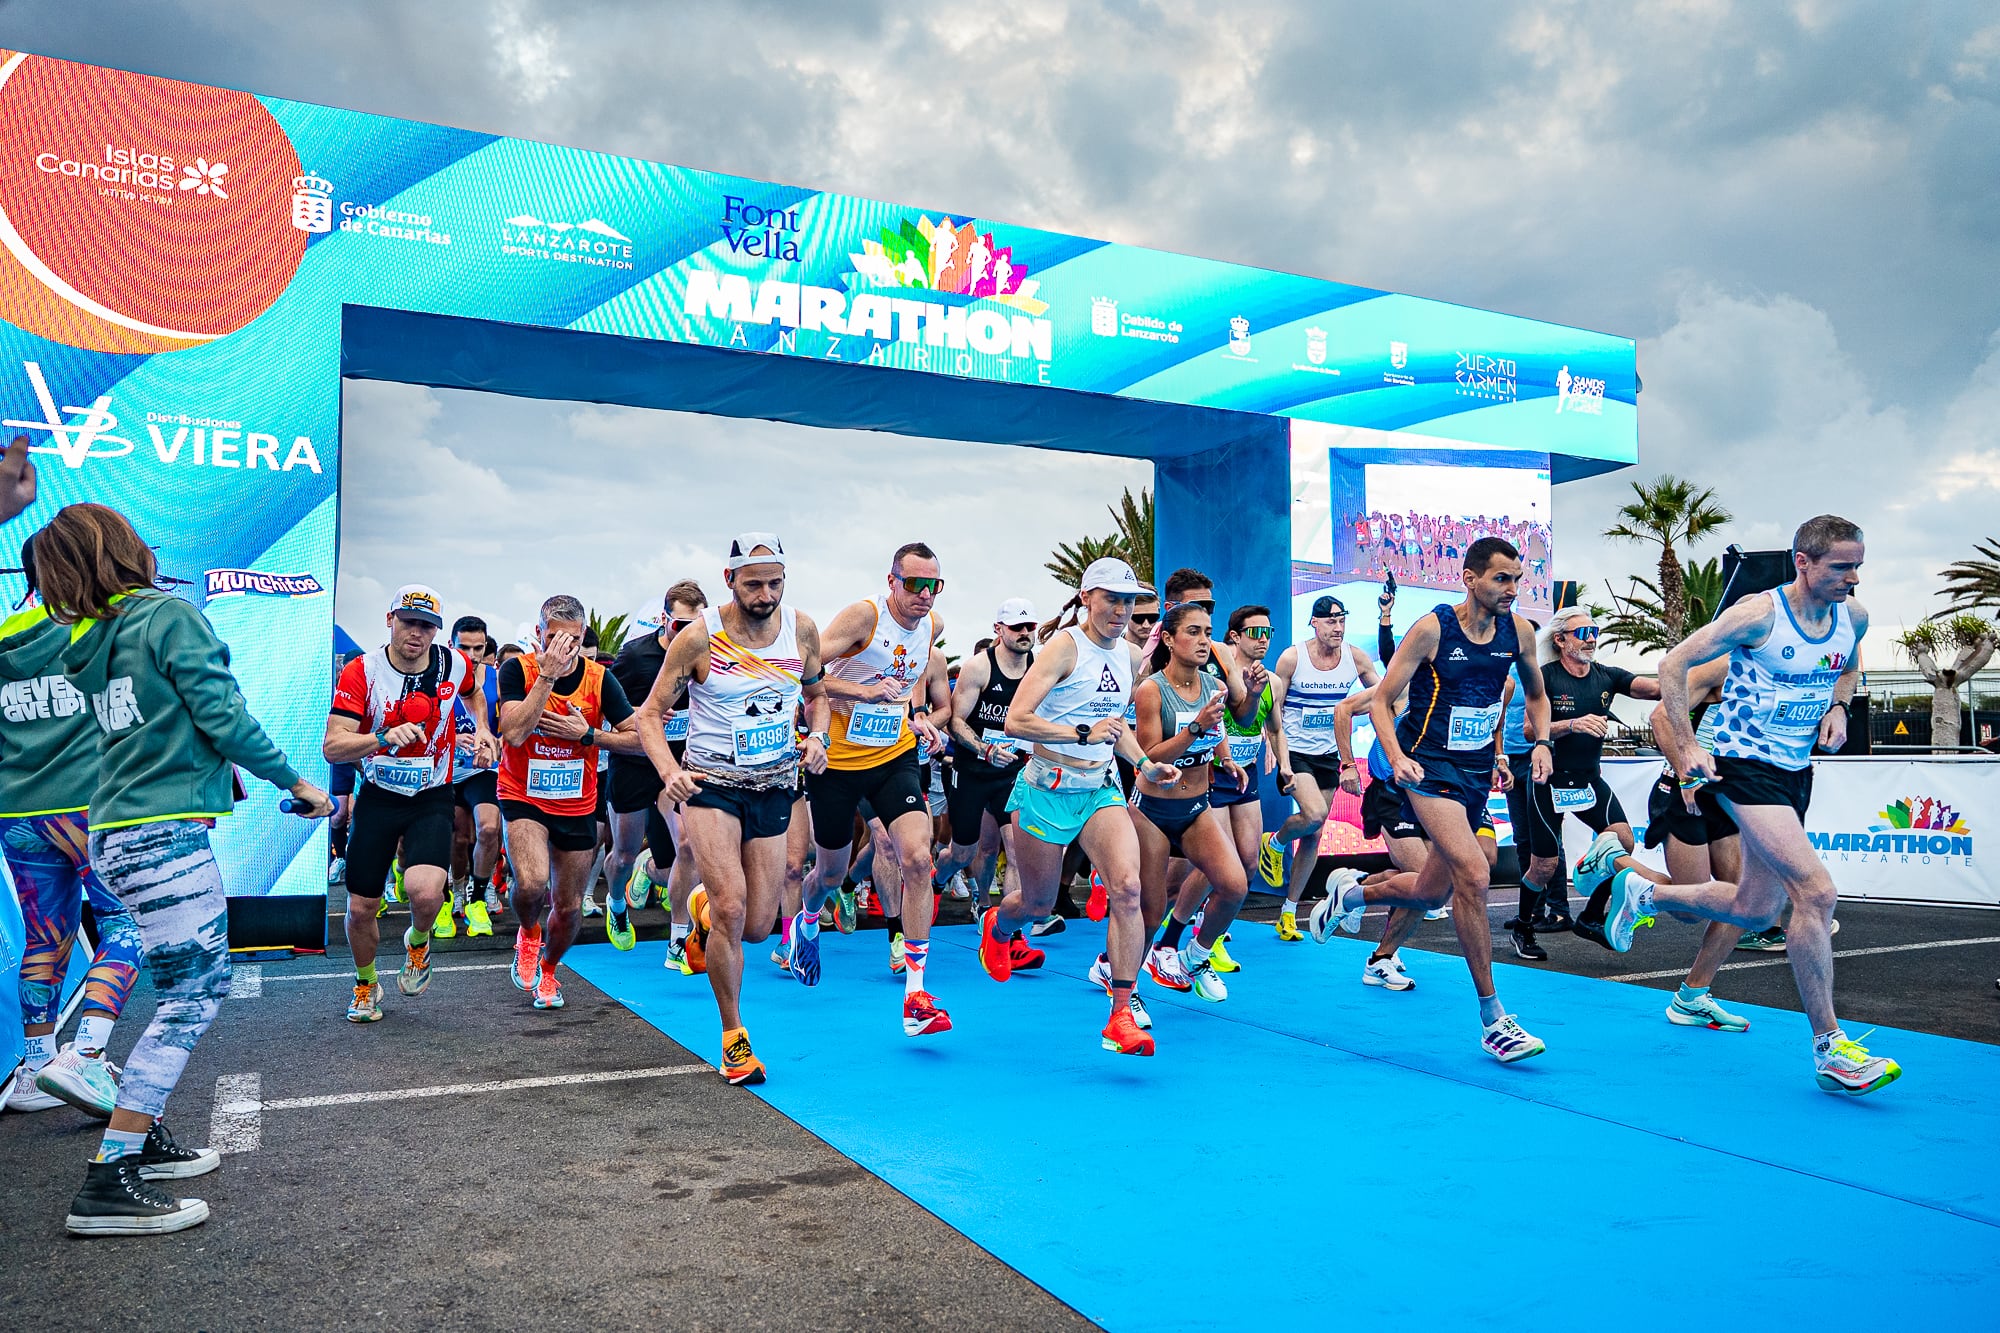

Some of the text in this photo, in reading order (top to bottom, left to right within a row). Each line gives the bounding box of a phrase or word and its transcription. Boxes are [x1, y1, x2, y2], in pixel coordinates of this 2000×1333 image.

[106, 144, 175, 172] Islas
[36, 152, 174, 190] Canarias
[339, 201, 433, 226] Gobierno
[722, 195, 800, 232] Font
[339, 217, 452, 246] de Canarias
[503, 228, 634, 259] LANZAROTE
[720, 224, 801, 263] Vella
[502, 244, 634, 271] SPORTS DESTINATION
[684, 269, 1052, 361] MARATHON
[1121, 312, 1183, 333] Cabildo de
[1121, 325, 1180, 344] Lanzarote
[685, 321, 1052, 384] LANZAROTE
[1571, 386, 1604, 399] BEACH
[1573, 375, 1606, 391] SANDS
[146, 411, 242, 430] Distribuciones
[146, 424, 323, 474] VIERA
[208, 570, 320, 594] Munchitos
[1301, 681, 1336, 689] Lochaber.
[3, 696, 87, 723] GIVE UP!
[1311, 716, 1332, 725] 4515
[1787, 704, 1821, 721] 4922
[865, 717, 891, 733] 4121
[749, 728, 784, 749] 4898
[388, 769, 419, 784] 4776
[542, 773, 571, 787] 5015
[1806, 831, 1973, 856] MARATHON
[1820, 852, 1973, 868] ANZAROTE
